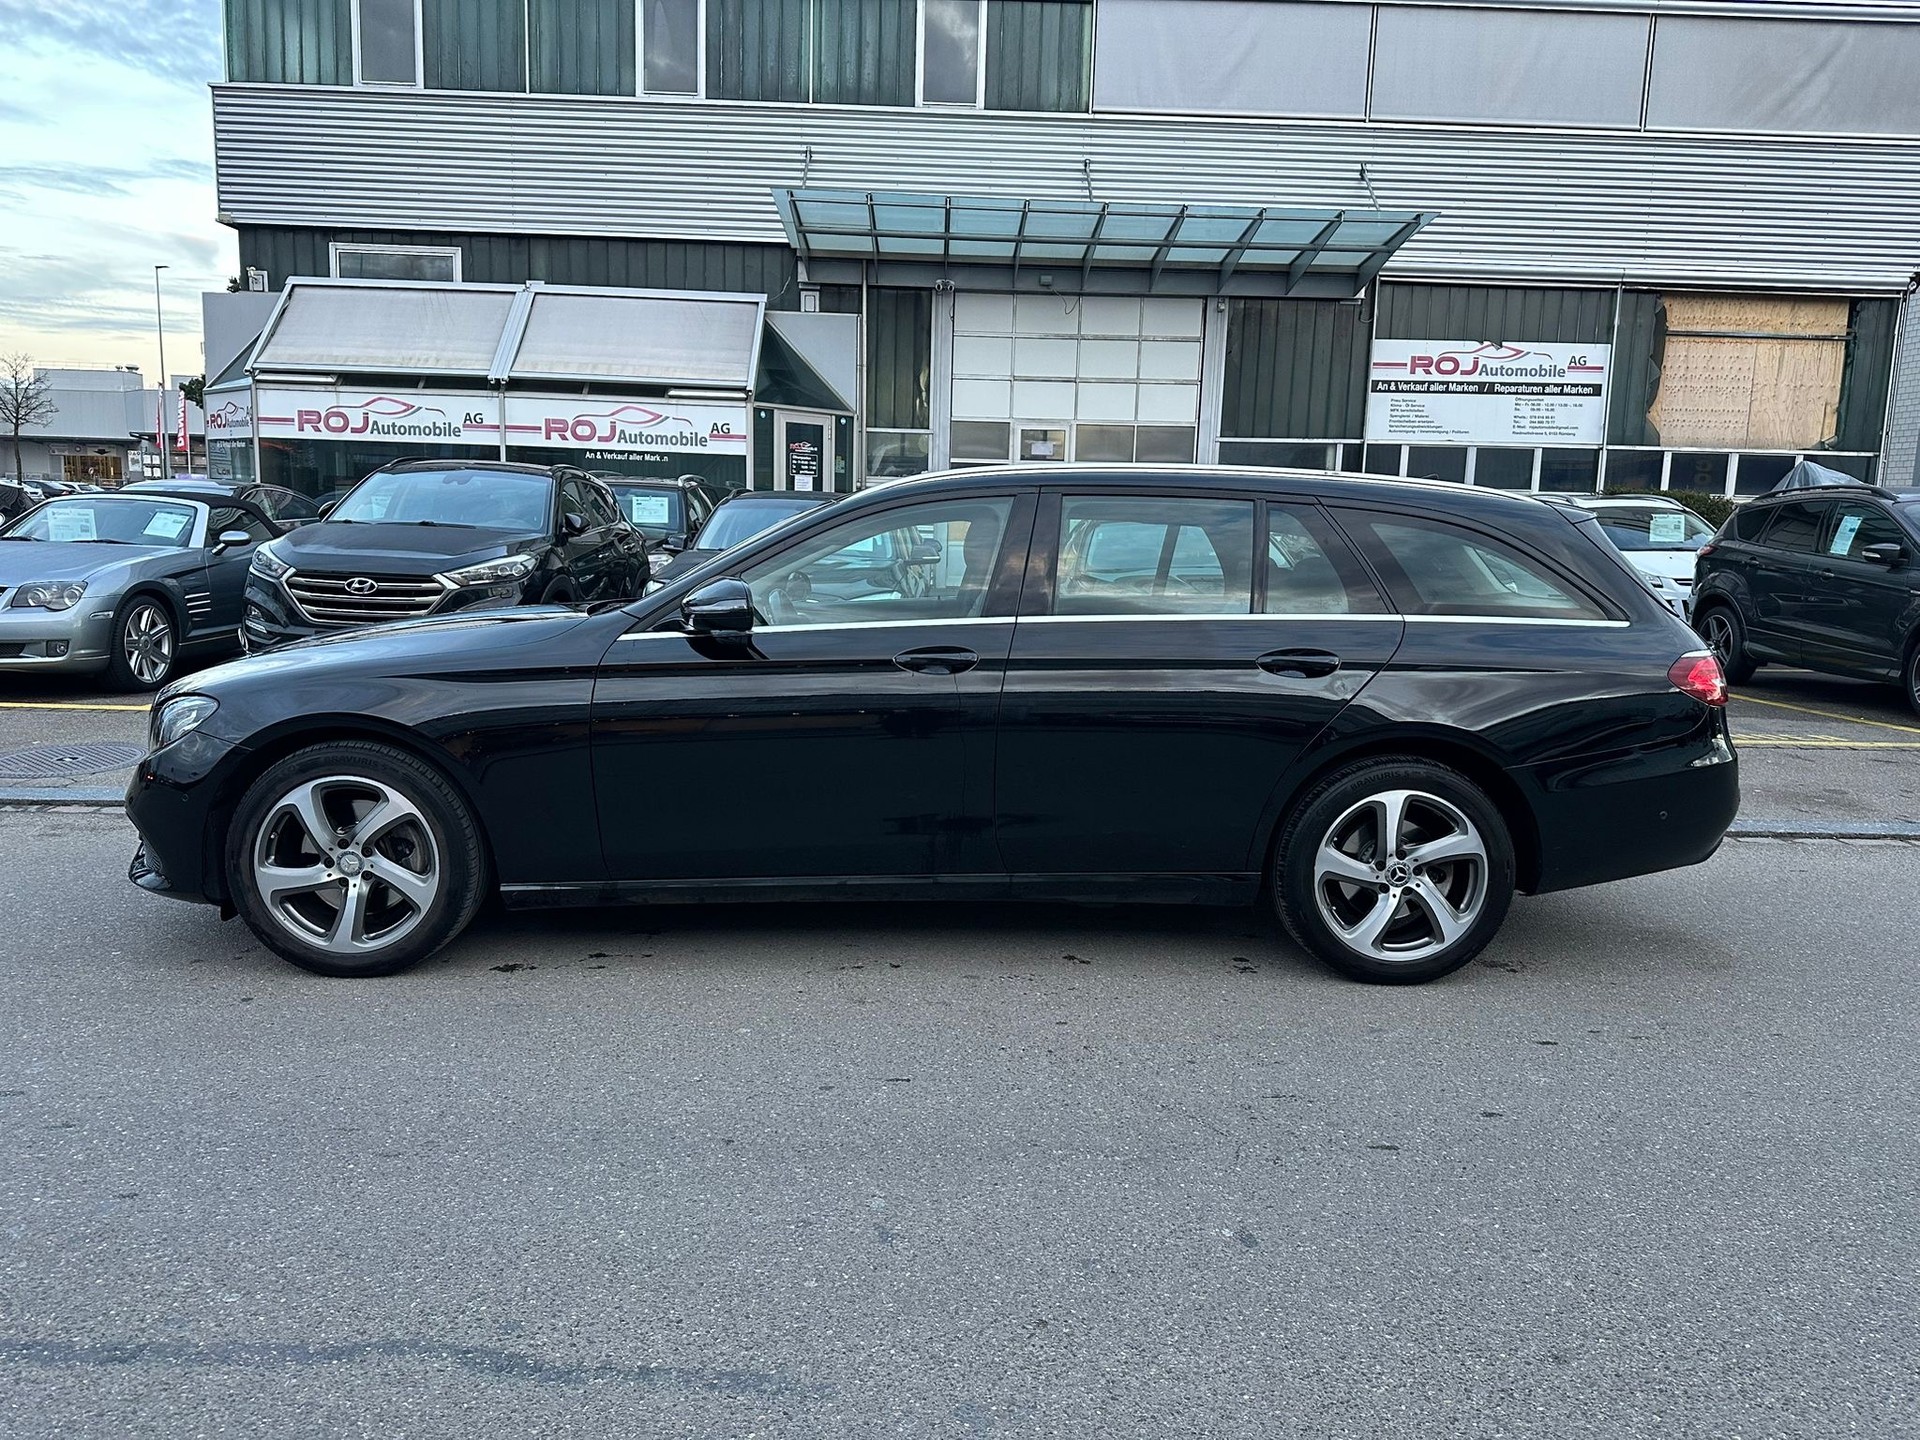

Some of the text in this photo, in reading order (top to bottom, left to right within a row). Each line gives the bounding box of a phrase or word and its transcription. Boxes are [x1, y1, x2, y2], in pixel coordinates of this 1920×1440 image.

[1409, 355, 1587, 378] ROJ Automobile AG
[1376, 382, 1389, 391] An
[1390, 382, 1396, 391] &
[1397, 382, 1428, 392] Verkauf
[1428, 382, 1447, 392] aller
[1448, 383, 1479, 393] Marken
[1494, 383, 1543, 395] Reparaturen
[1544, 384, 1561, 394] aller
[1562, 385, 1593, 395] Marken
[210, 413, 227, 429] ROJ
[297, 409, 484, 437] ROJ Automobile AG
[544, 417, 731, 448] ROJ Automobile AG
[585, 451, 595, 459] An
[596, 451, 602, 459] &
[603, 452, 628, 460] Verkauf
[629, 453, 644, 461] aller
[1350, 771, 1401, 790] BRAVURIS
